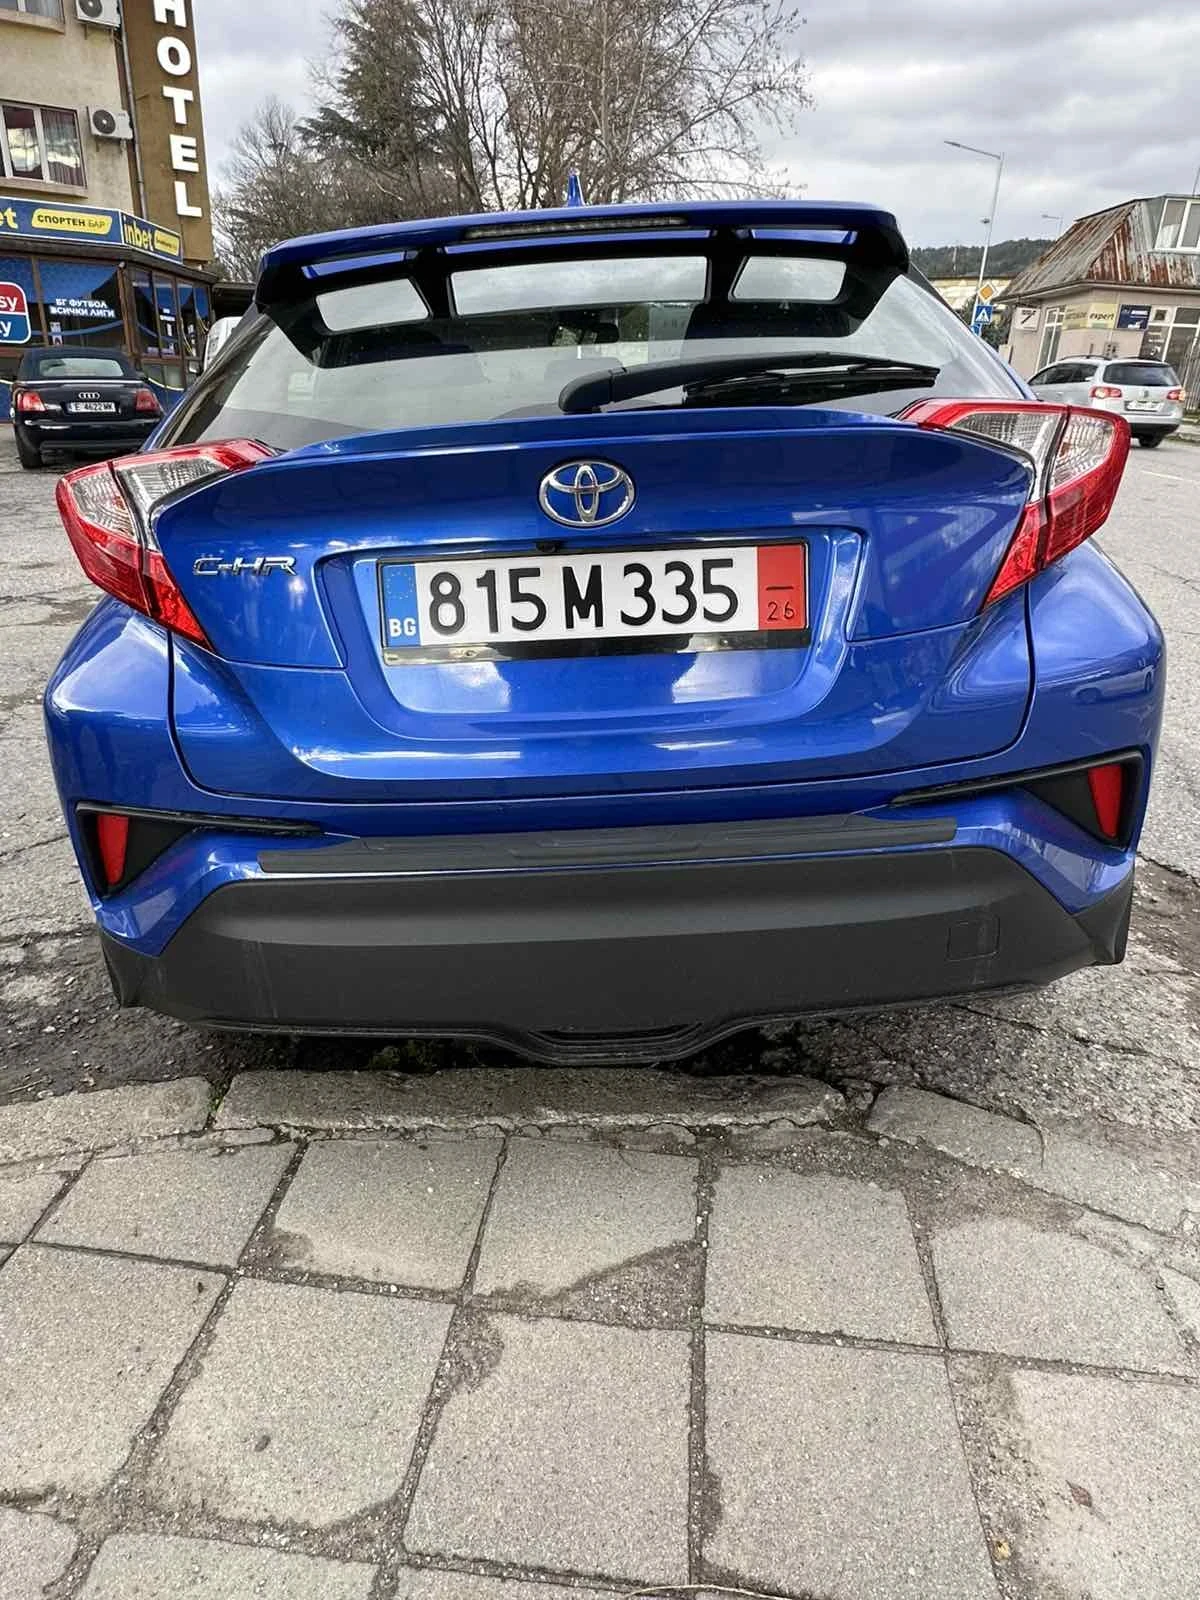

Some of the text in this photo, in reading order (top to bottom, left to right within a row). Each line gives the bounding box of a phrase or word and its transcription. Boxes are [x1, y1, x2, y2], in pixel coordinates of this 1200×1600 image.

[153, 0, 202, 217] HOTEL
[37, 214, 86, 227] СПОРТЕН
[123, 214, 154, 252] inbet
[49, 305, 116, 318] ВСИЧКИ ЛИГИ
[55, 298, 108, 309] БГ ФУТБОЛ
[1089, 312, 1115, 321] expert
[193, 556, 296, 576] C-HR
[429, 557, 739, 636] 815 M 335
[767, 601, 796, 622] 26
[388, 617, 417, 637] BG
